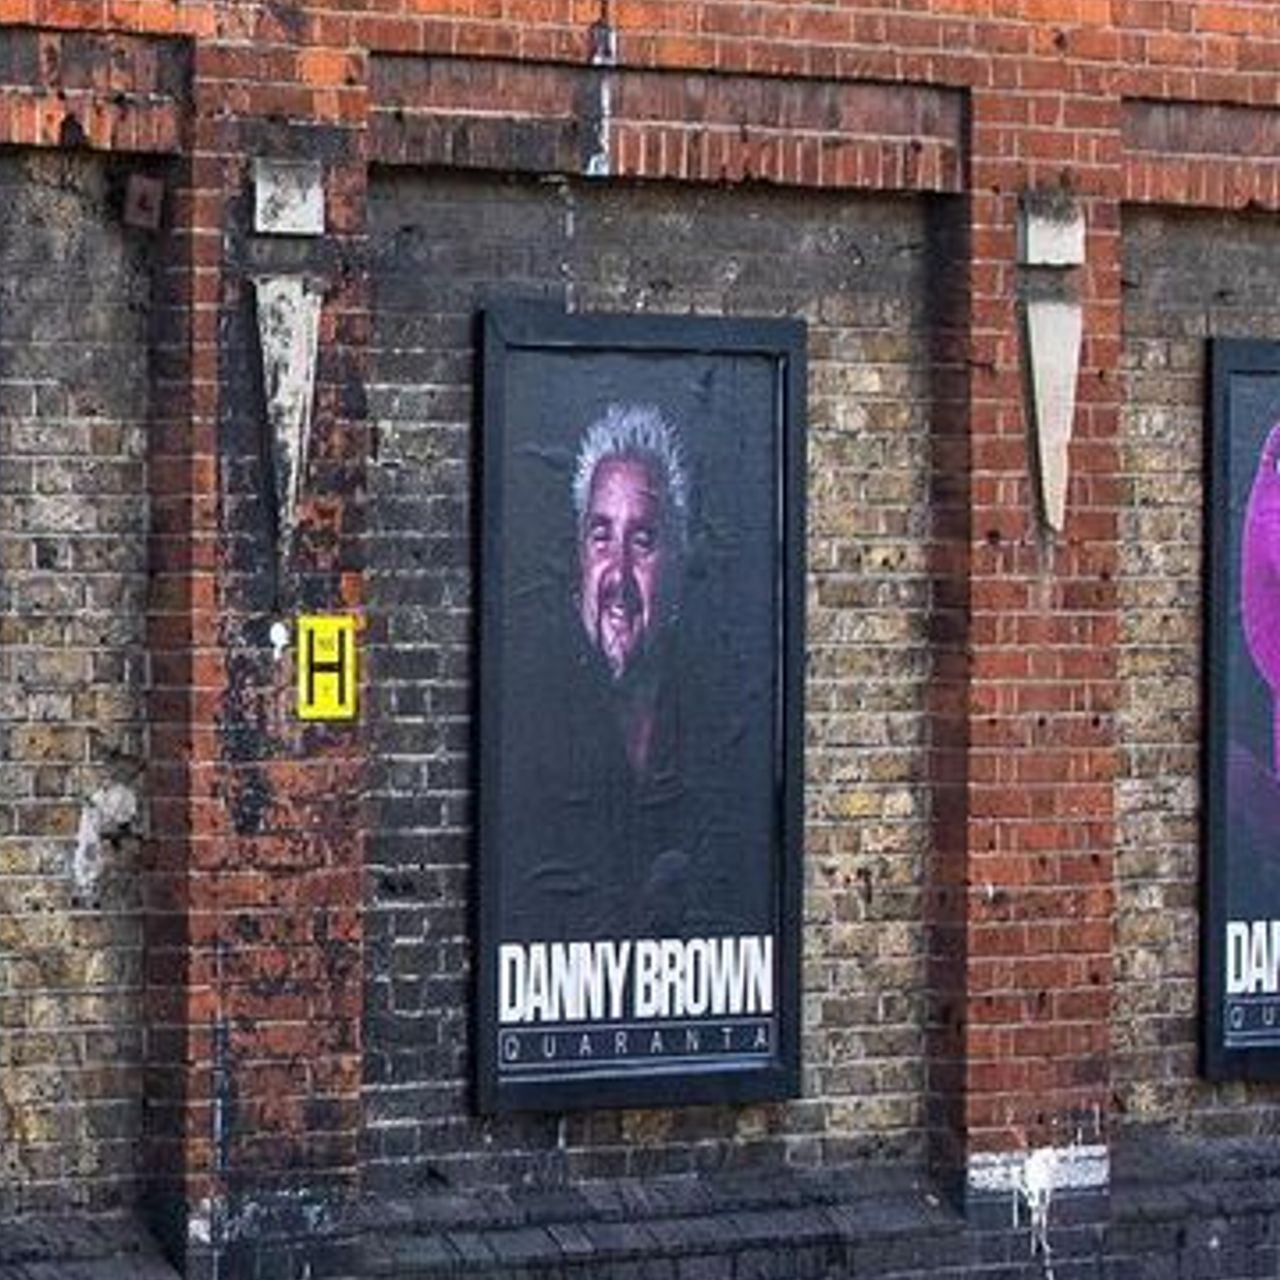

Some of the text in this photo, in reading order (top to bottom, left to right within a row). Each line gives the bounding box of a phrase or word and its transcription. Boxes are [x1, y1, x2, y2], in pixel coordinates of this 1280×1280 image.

[307, 627, 346, 706] H
[498, 935, 774, 1023] DANNY BROWN
[504, 1026, 768, 1061] QUARANTA
